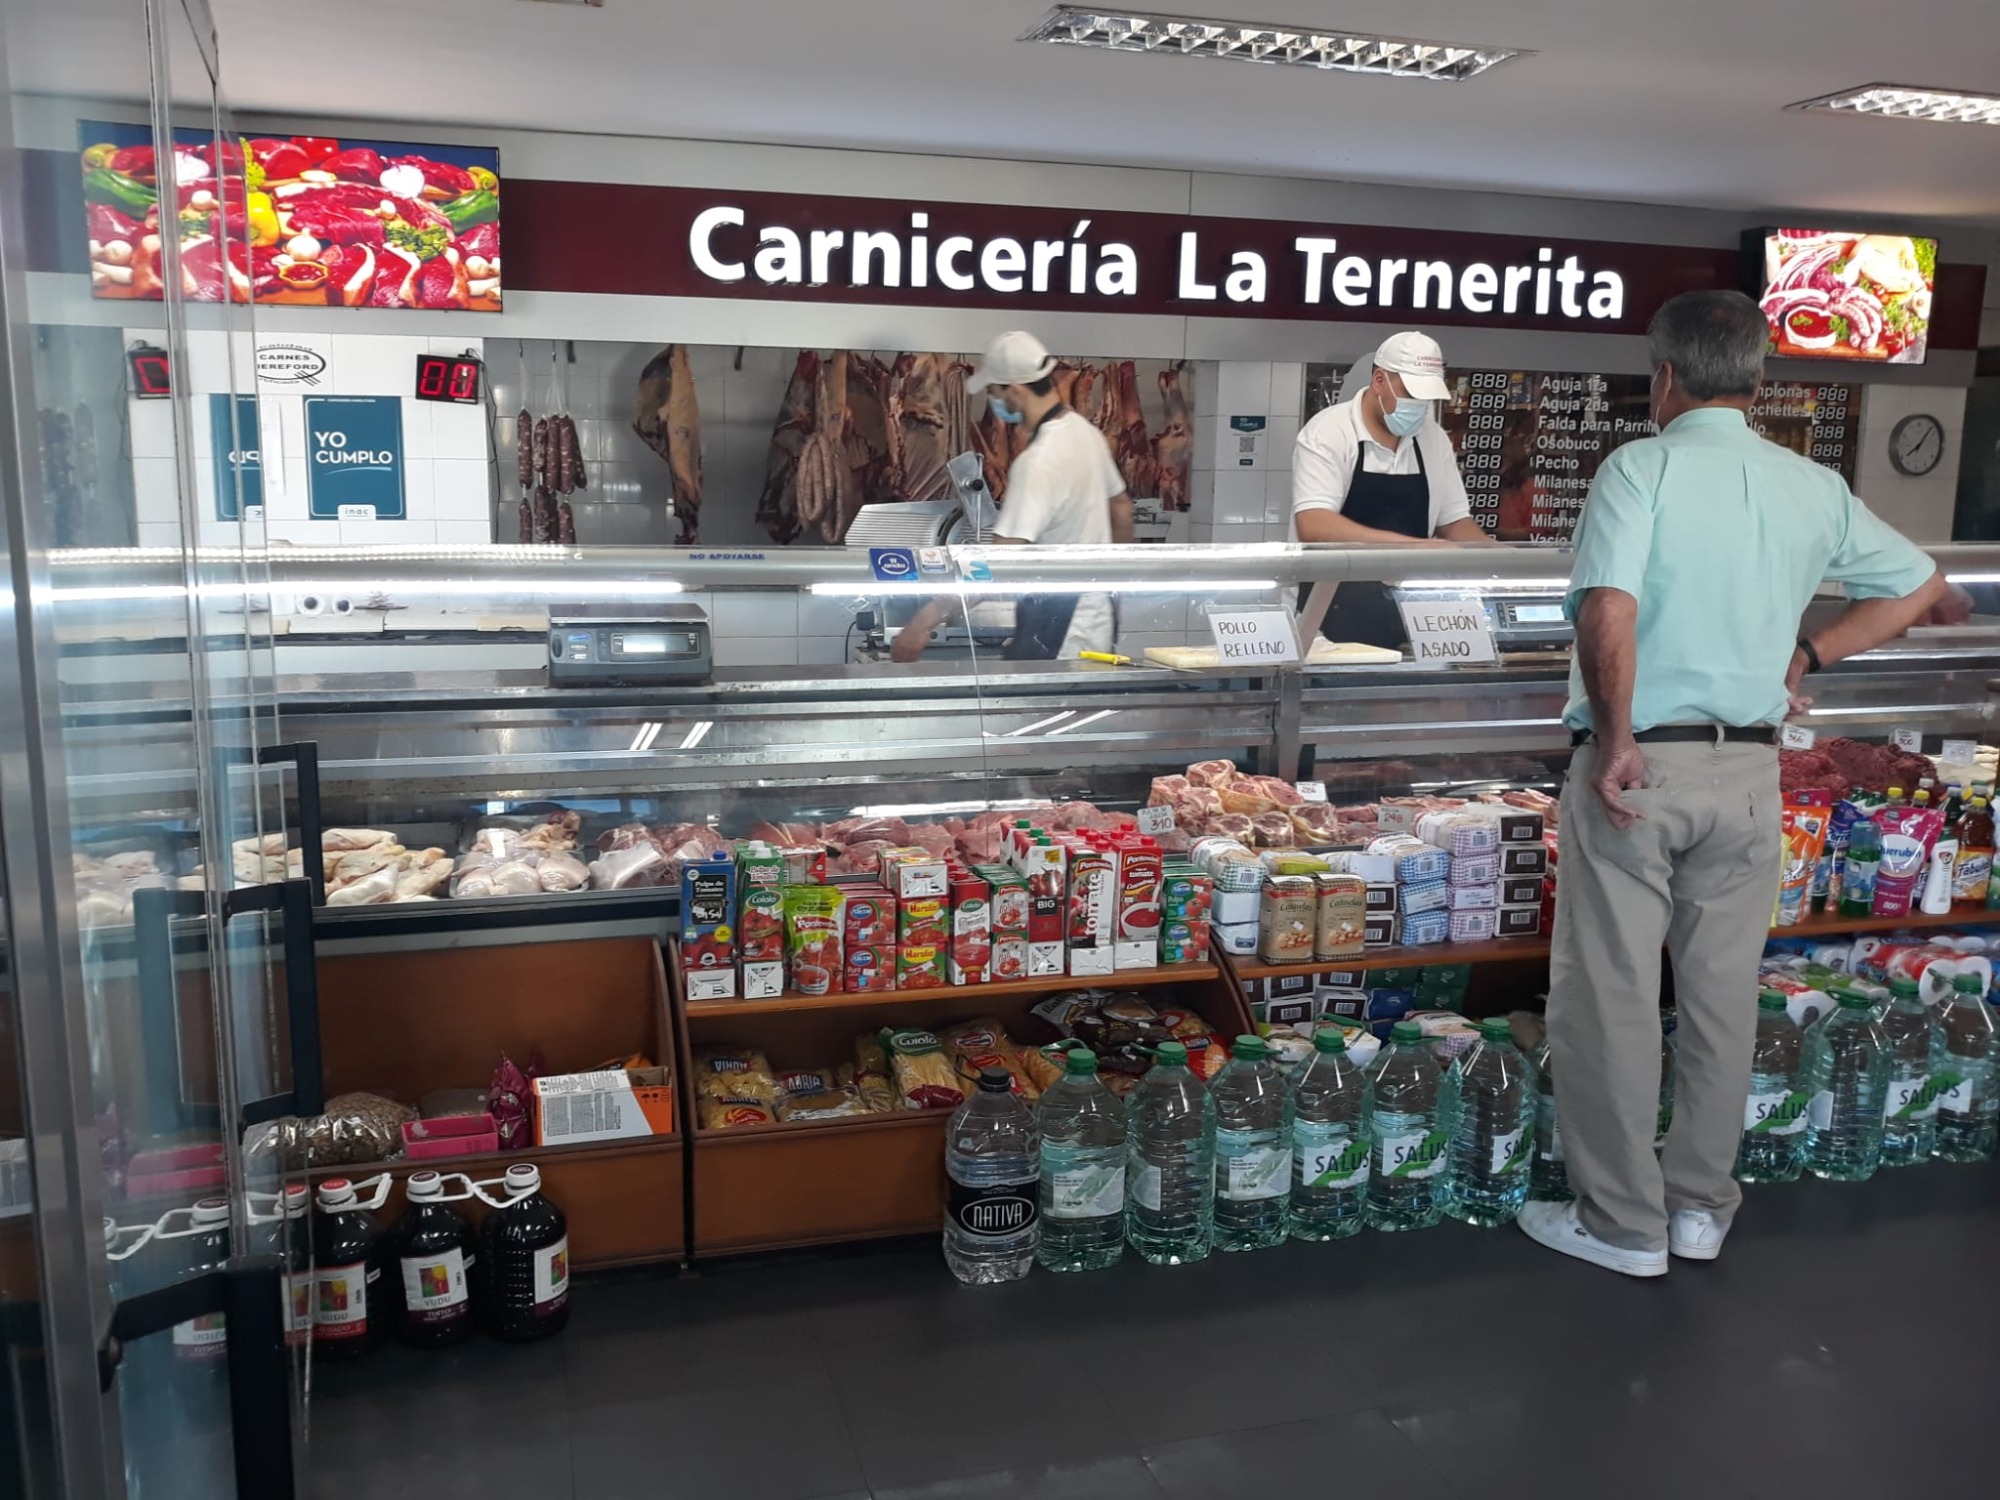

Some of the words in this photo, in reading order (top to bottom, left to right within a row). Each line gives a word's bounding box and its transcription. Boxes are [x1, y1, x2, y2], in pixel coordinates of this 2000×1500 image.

[688, 205, 1138, 296] Carnicería
[1178, 231, 1269, 304] La
[1295, 236, 1625, 320] Ternerita
[1541, 376, 1581, 392] Aguja
[1539, 395, 1580, 412] Aguja
[1538, 415, 1576, 431] Falda
[1580, 420, 1610, 434] para
[315, 431, 347, 448] YO
[1537, 434, 1600, 450] Osobuco
[315, 450, 393, 465] CUMPLO
[1536, 454, 1579, 469] Pecho
[1218, 621, 1257, 635] POLLO
[1223, 640, 1286, 658] RELLENO
[1420, 641, 1471, 658] ASADO
[1037, 900, 1056, 909] BIG
[1394, 1139, 1447, 1164] SALUS
[1314, 1148, 1369, 1174] SALUS
[973, 1201, 1024, 1228] NATIVA
